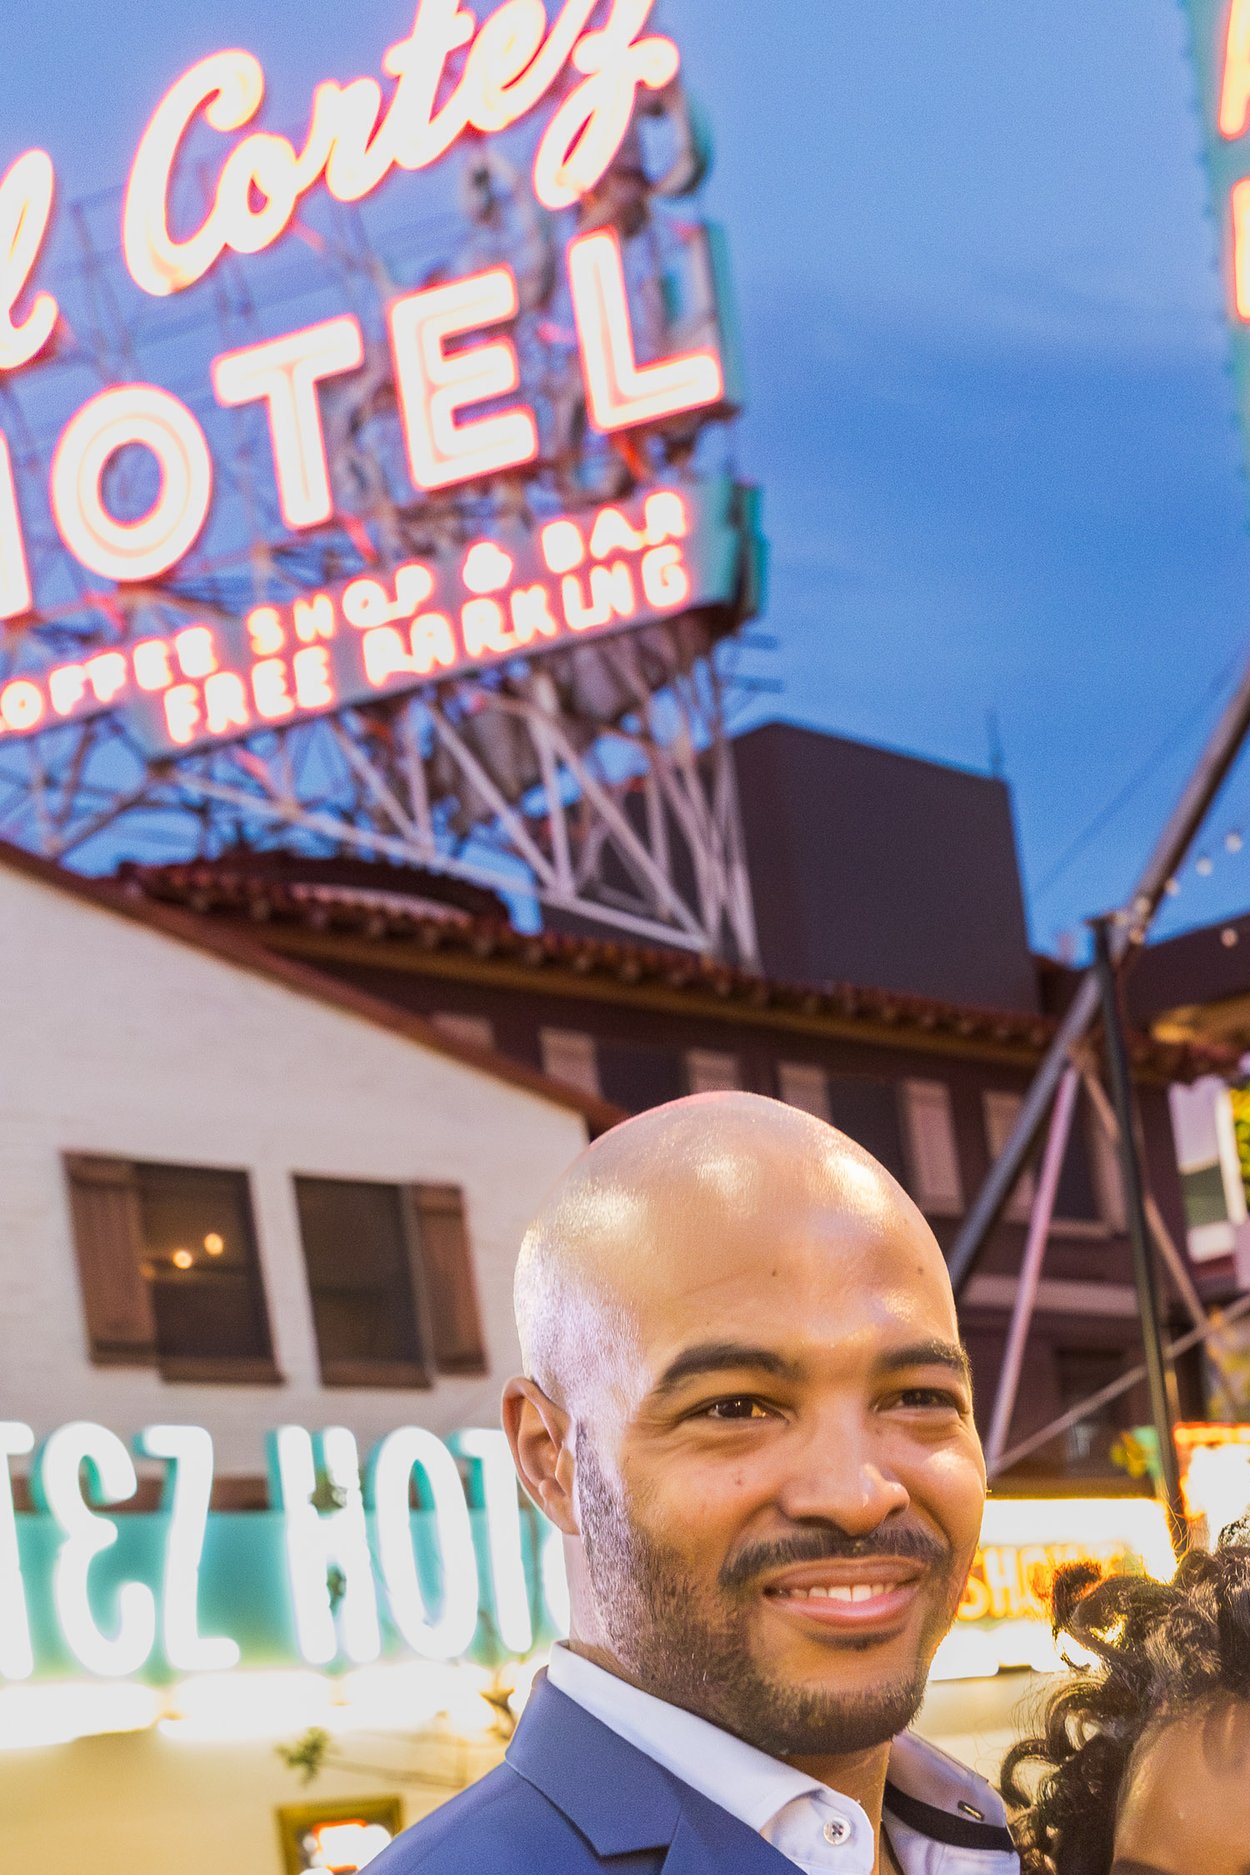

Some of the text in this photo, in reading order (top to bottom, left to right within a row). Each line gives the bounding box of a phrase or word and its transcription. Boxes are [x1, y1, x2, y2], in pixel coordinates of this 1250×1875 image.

[0, 0, 681, 370] l Cortez
[0, 227, 724, 620] OTEL
[0, 624, 218, 735] OFFEE
[162, 542, 689, 746] FREE PARKING
[274, 1424, 572, 1665] HOT
